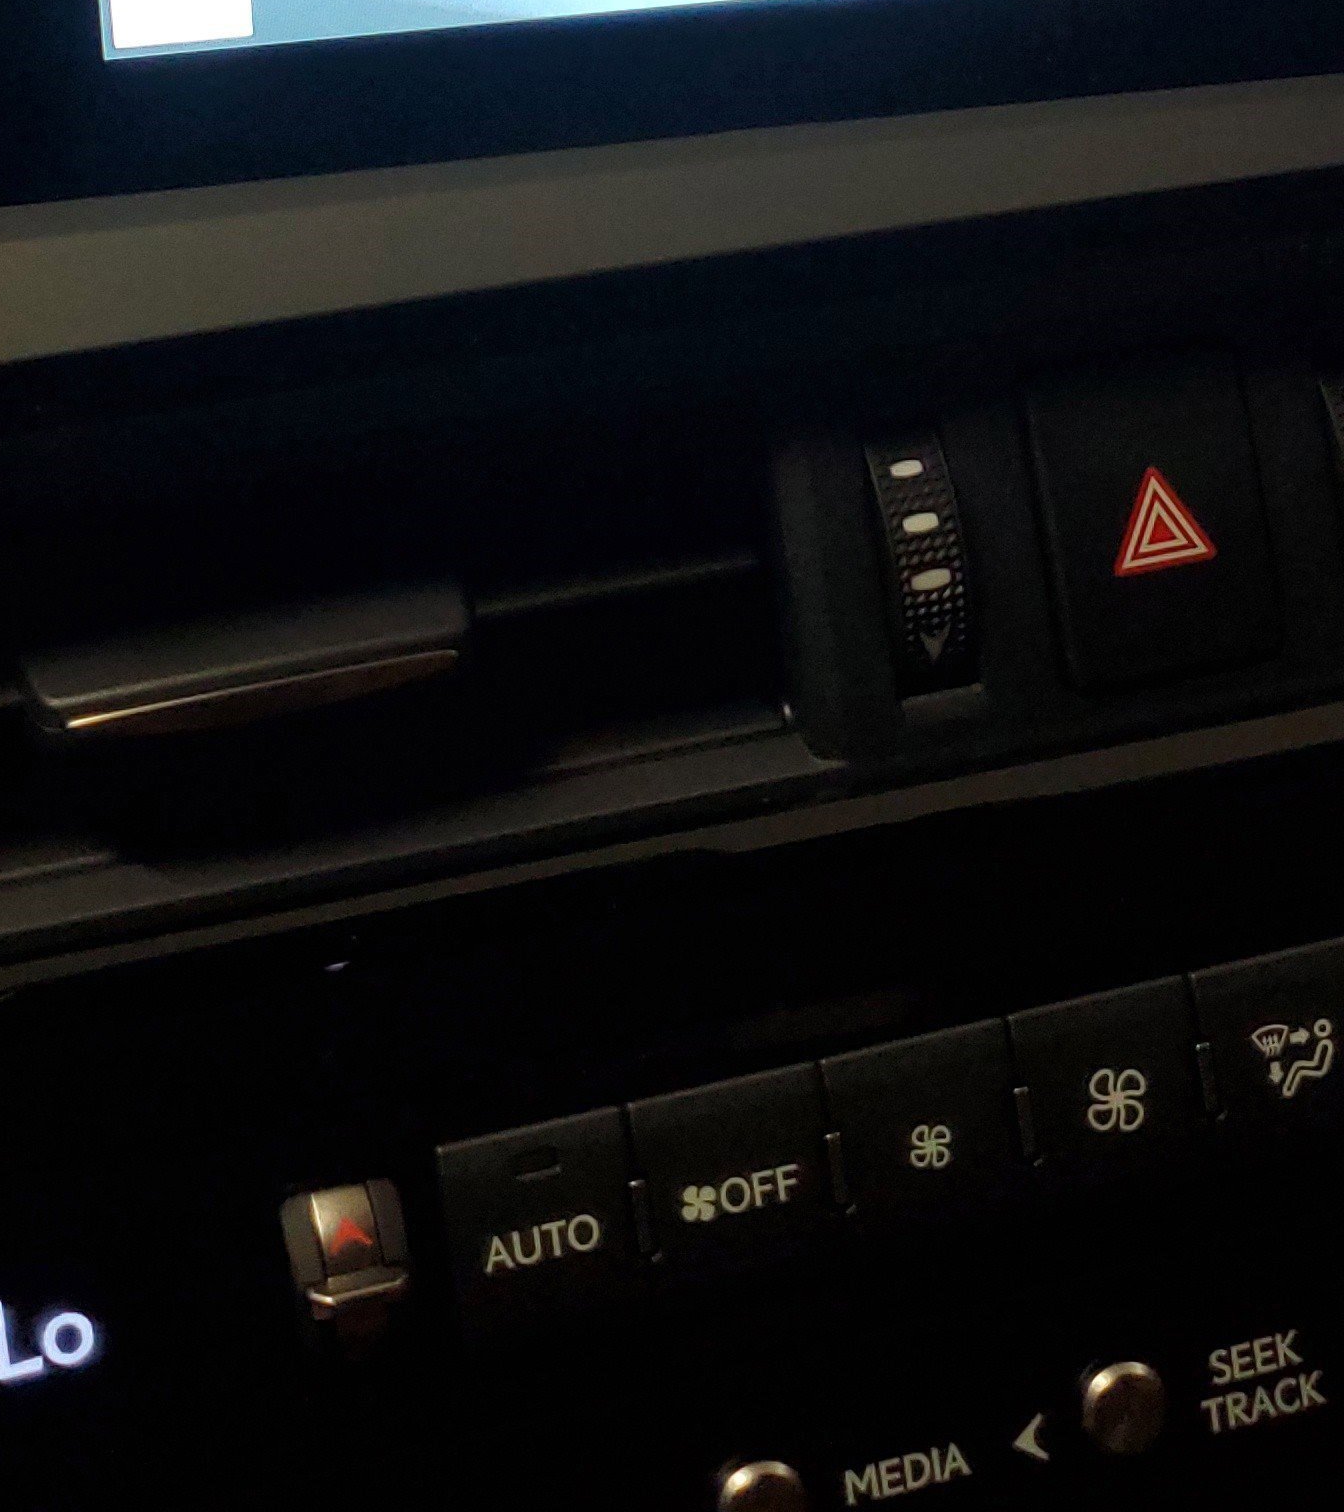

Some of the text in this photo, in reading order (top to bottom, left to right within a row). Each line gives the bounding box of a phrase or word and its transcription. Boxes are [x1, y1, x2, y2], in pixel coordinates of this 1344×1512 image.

[720, 1162, 800, 1216] OFF
[483, 1213, 602, 1274] AUTO
[1208, 1329, 1304, 1386] SEEK
[1200, 1370, 1328, 1435] TRACK
[843, 1441, 973, 1506] MEDIA
